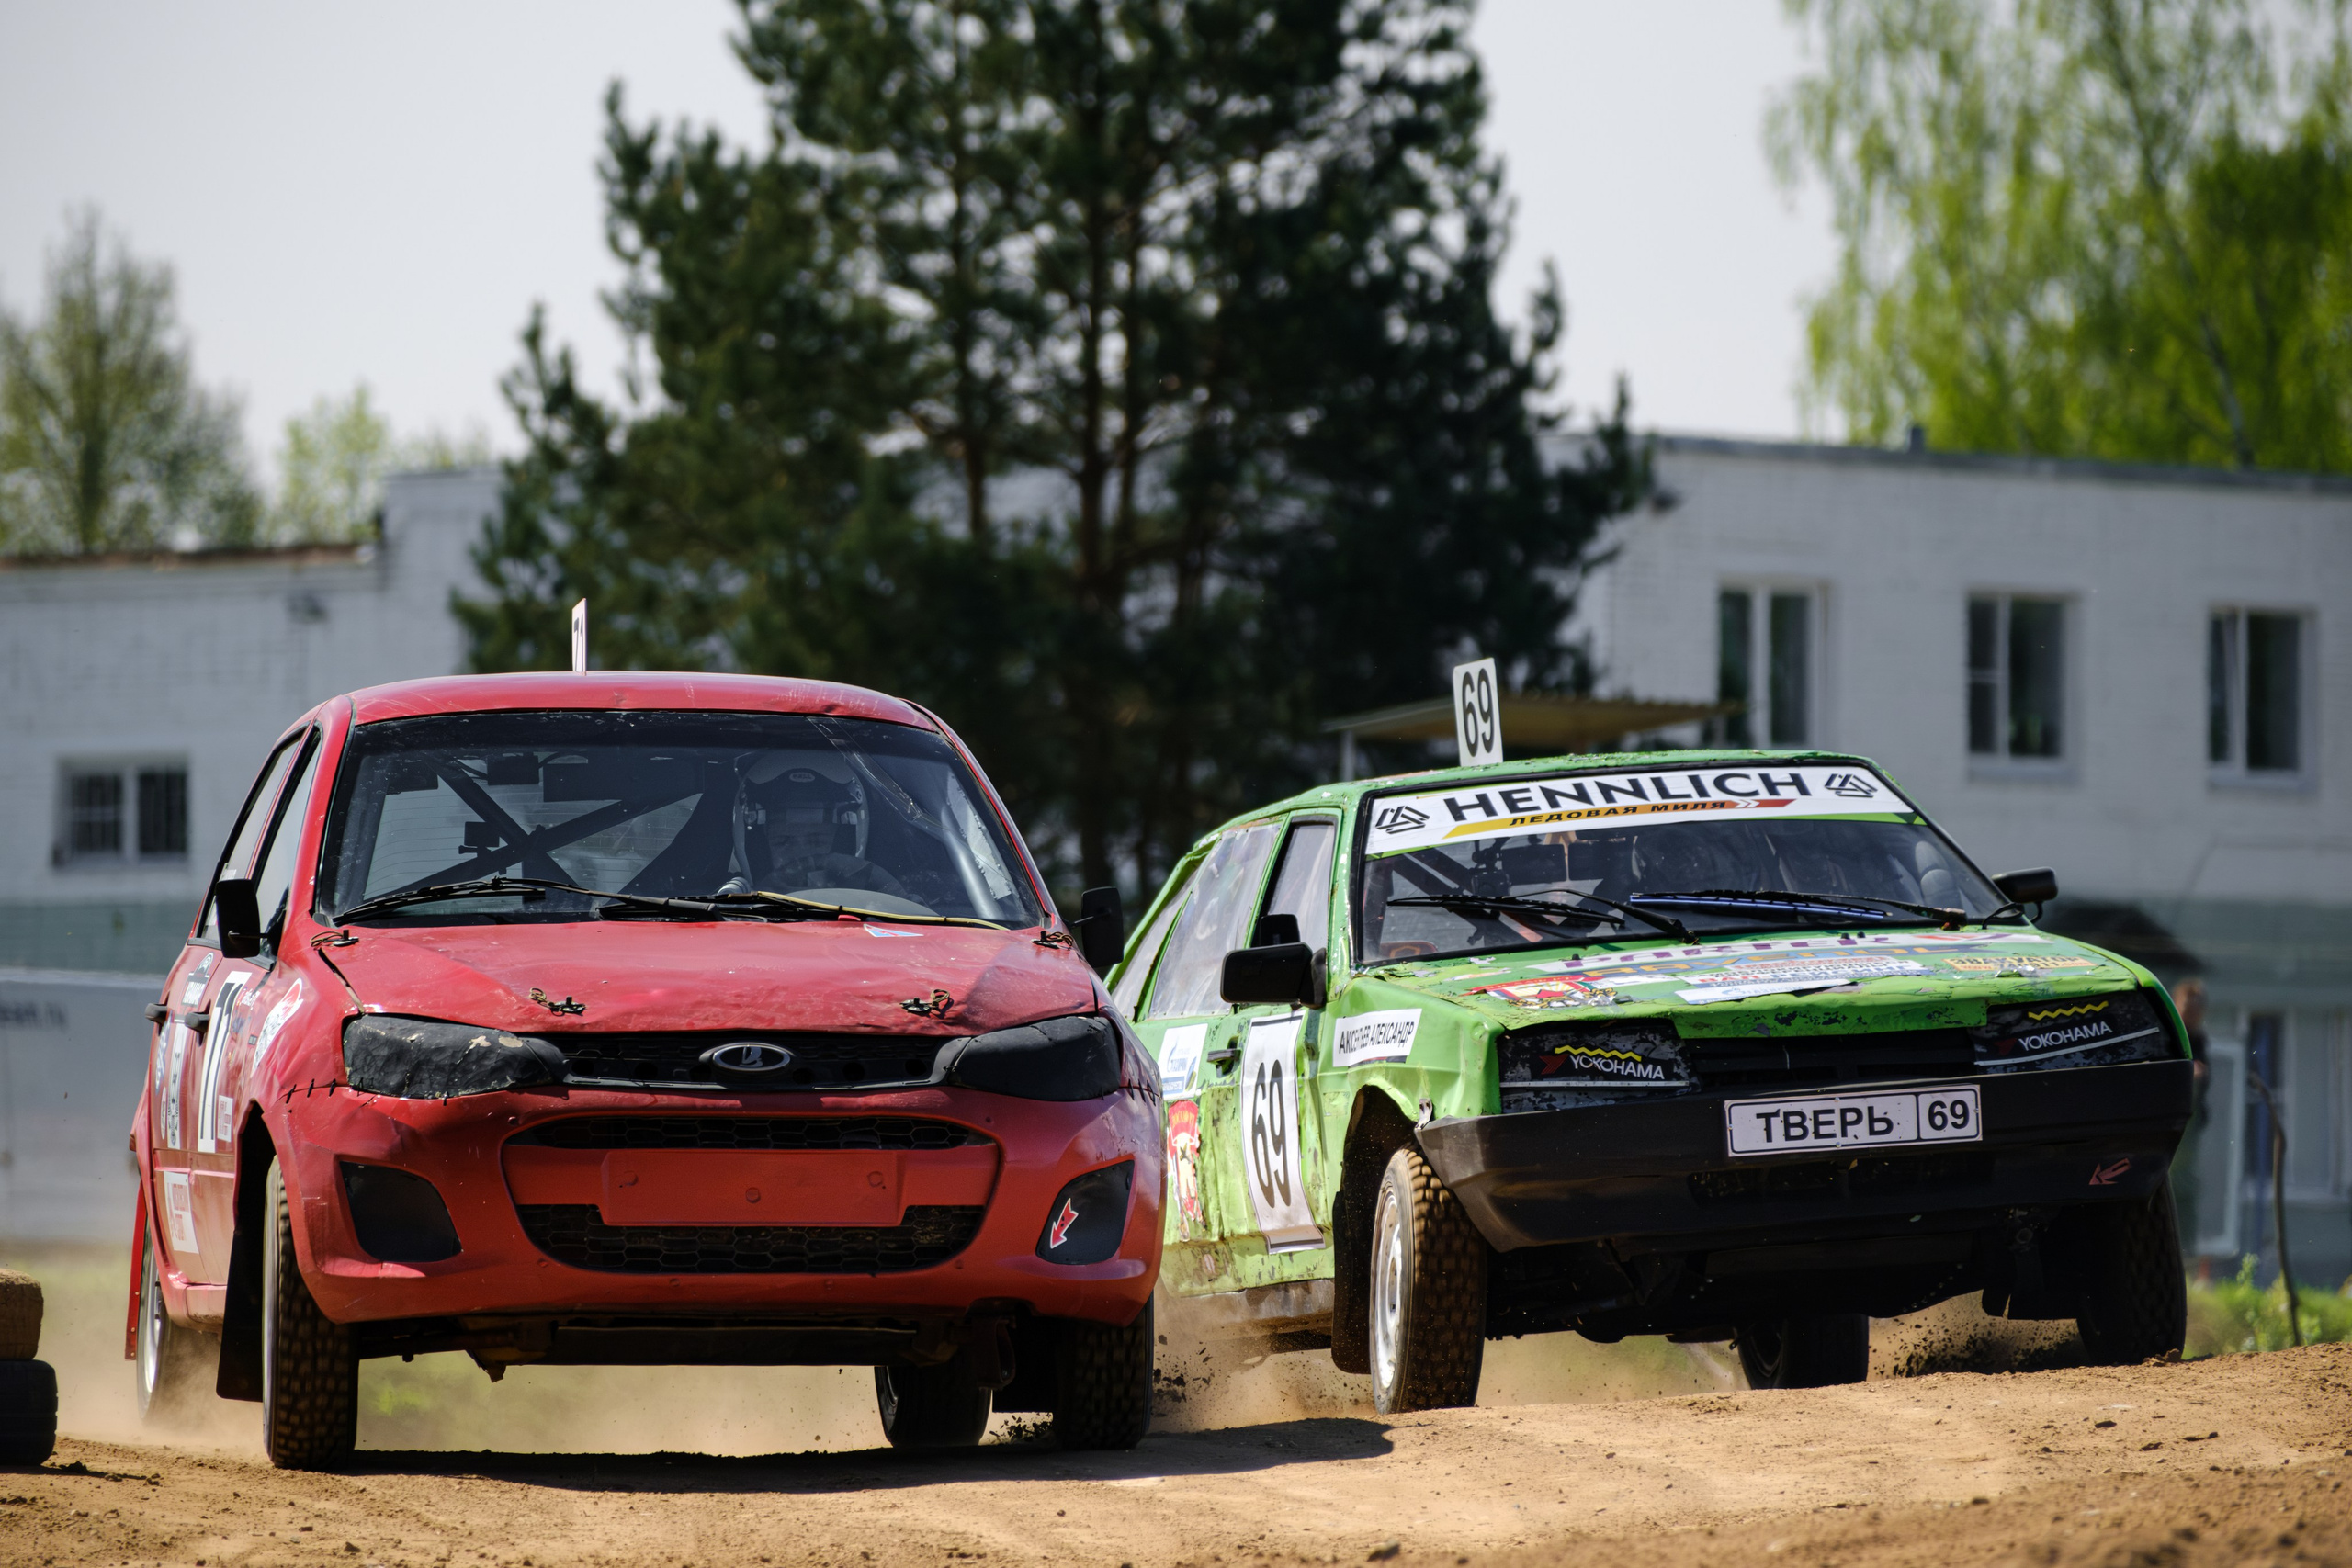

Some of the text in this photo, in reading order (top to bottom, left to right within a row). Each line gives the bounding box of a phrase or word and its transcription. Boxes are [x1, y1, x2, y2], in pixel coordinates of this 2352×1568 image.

[1462, 668, 1495, 758] 69
[1443, 773, 1813, 822] HENNLICH
[1509, 801, 1726, 826] ЛЕДОВАЯ МИЛЯ
[1582, 946, 1961, 977] RAVENOL
[1369, 1021, 1415, 1048] АЛЕКСАНДР
[2018, 1021, 2113, 1051] YOKOHAMA
[1569, 1055, 1665, 1079] YOKOHAMA
[1252, 1059, 1292, 1209] 69
[1756, 1100, 1970, 1143] ТВЕРЬ 69
